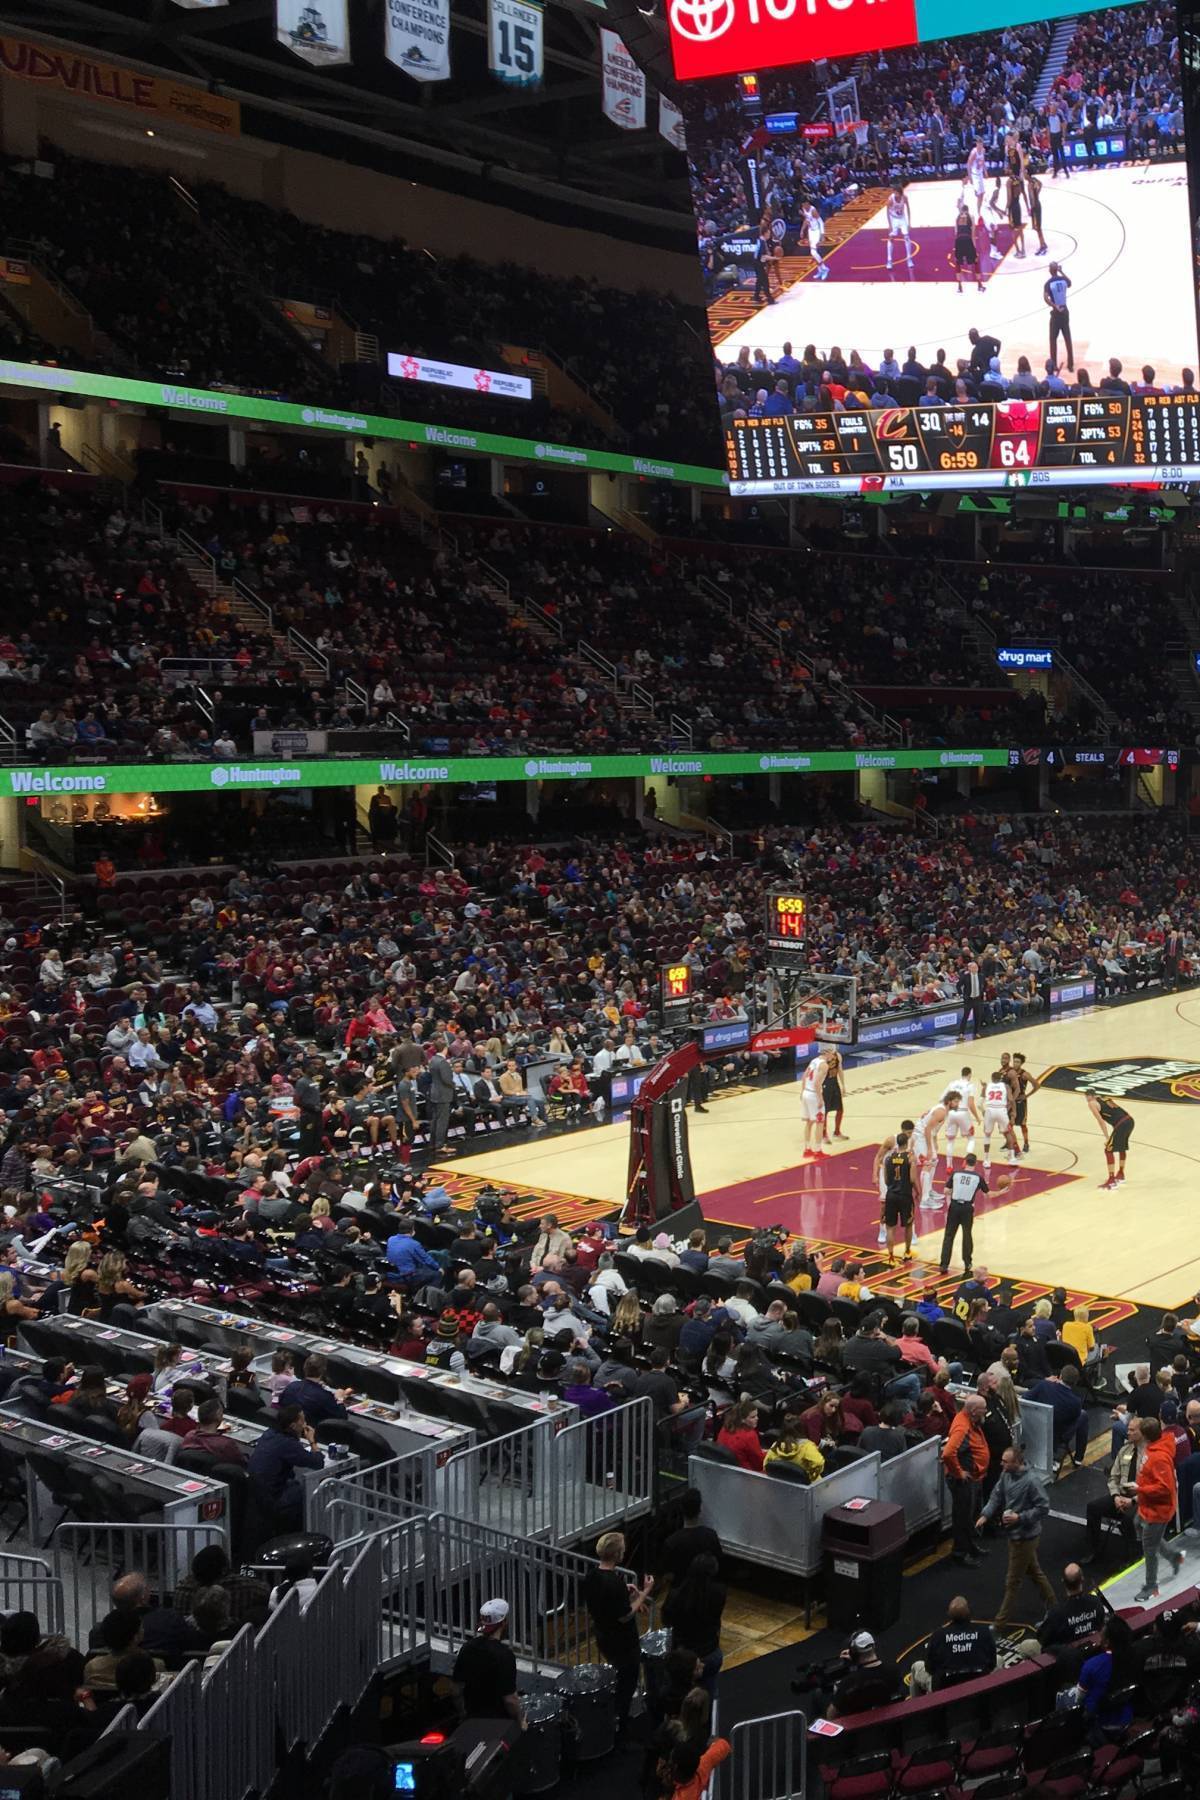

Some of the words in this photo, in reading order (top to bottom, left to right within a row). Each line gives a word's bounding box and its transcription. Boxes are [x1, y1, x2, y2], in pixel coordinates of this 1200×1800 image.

[389, 1, 447, 29] CONFERENCE
[392, 16, 446, 45] CHAMPIONS
[499, 20, 536, 73] 15
[603, 64, 643, 87] CONFERENCE
[421, 366, 454, 377] REPUBLIC
[493, 379, 523, 390] REPUBLIC
[1174, 395, 1185, 404] AST
[1187, 394, 1199, 403] FLS
[1048, 406, 1073, 415] FOULS
[1083, 403, 1104, 416] FG%
[1108, 402, 1122, 415] 50
[1147, 408, 1154, 418] 7
[1191, 406, 1196, 416] 1
[793, 419, 813, 430] FG%
[815, 418, 828, 429] 35
[840, 417, 863, 426] FOULS
[920, 412, 942, 431] 3Q
[971, 412, 990, 427] 14
[1046, 415, 1077, 424] COMMITTED
[1147, 419, 1157, 430] 10
[161, 387, 228, 412] Welcome
[315, 410, 367, 430] Huntington
[424, 426, 477, 447] Welcome
[546, 445, 588, 462] Huntington
[633, 459, 676, 478] Welcome
[777, 427, 784, 437] 2
[838, 426, 867, 434] COMMITTED
[949, 424, 964, 437] -14
[1056, 427, 1066, 442] 2
[1080, 427, 1106, 440] 3PT%
[1107, 425, 1121, 438] 53
[1164, 430, 1170, 440] 4
[1179, 429, 1186, 440] 2
[1192, 429, 1199, 439] 2
[797, 440, 821, 452] 3PT%
[823, 440, 836, 450] 29
[852, 437, 859, 451] 1
[1164, 441, 1171, 451] 2
[1181, 440, 1185, 451] 1
[1194, 440, 1198, 450] 1
[888, 444, 918, 471] 50
[939, 450, 978, 469] 6:59
[999, 439, 1030, 467] 64
[1079, 451, 1097, 464] TOL
[1107, 449, 1116, 463] 4
[1165, 452, 1172, 462] 4
[1193, 451, 1200, 462] 2
[807, 463, 824, 474] TOL
[832, 461, 840, 473] 5
[1161, 468, 1183, 479] 6:00
[889, 477, 905, 488] MIA
[1031, 471, 1050, 482] BOS
[773, 482, 787, 490] OUT
[787, 482, 795, 490] OF
[795, 481, 814, 490] TOWN
[815, 480, 840, 489] SCORES
[998, 650, 1024, 666] drug
[1027, 650, 1052, 664] mart
[1009, 755, 1020, 765] 35
[1046, 751, 1054, 765] 4
[1074, 753, 1105, 763] STEALS
[1125, 752, 1134, 764] 4
[10, 771, 105, 792] Welcome
[229, 766, 301, 785] Huntington
[379, 762, 449, 782] Welcome
[538, 760, 592, 776] Huntington
[650, 757, 704, 774] Welcome
[770, 755, 811, 770] Huntington
[855, 753, 897, 769] Welcome
[948, 751, 984, 765] Huntington
[777, 897, 803, 914] 6:59
[780, 914, 799, 936] 14
[778, 940, 805, 950] TISSOT
[669, 967, 689, 981] 6:59
[671, 980, 686, 994] 14
[714, 1033, 731, 1044] drug
[731, 1030, 748, 1041] mart
[857, 1032, 885, 1043] Mucinex
[890, 1026, 911, 1038] Mucus
[911, 1023, 924, 1032] Out.
[673, 1113, 682, 1155] Cleveland
[676, 1155, 685, 1180] Clinic
[1067, 1609, 1096, 1627] Medical
[1075, 1622, 1092, 1636] Staff
[945, 1631, 978, 1644] Medical
[951, 1642, 973, 1654] Staff
